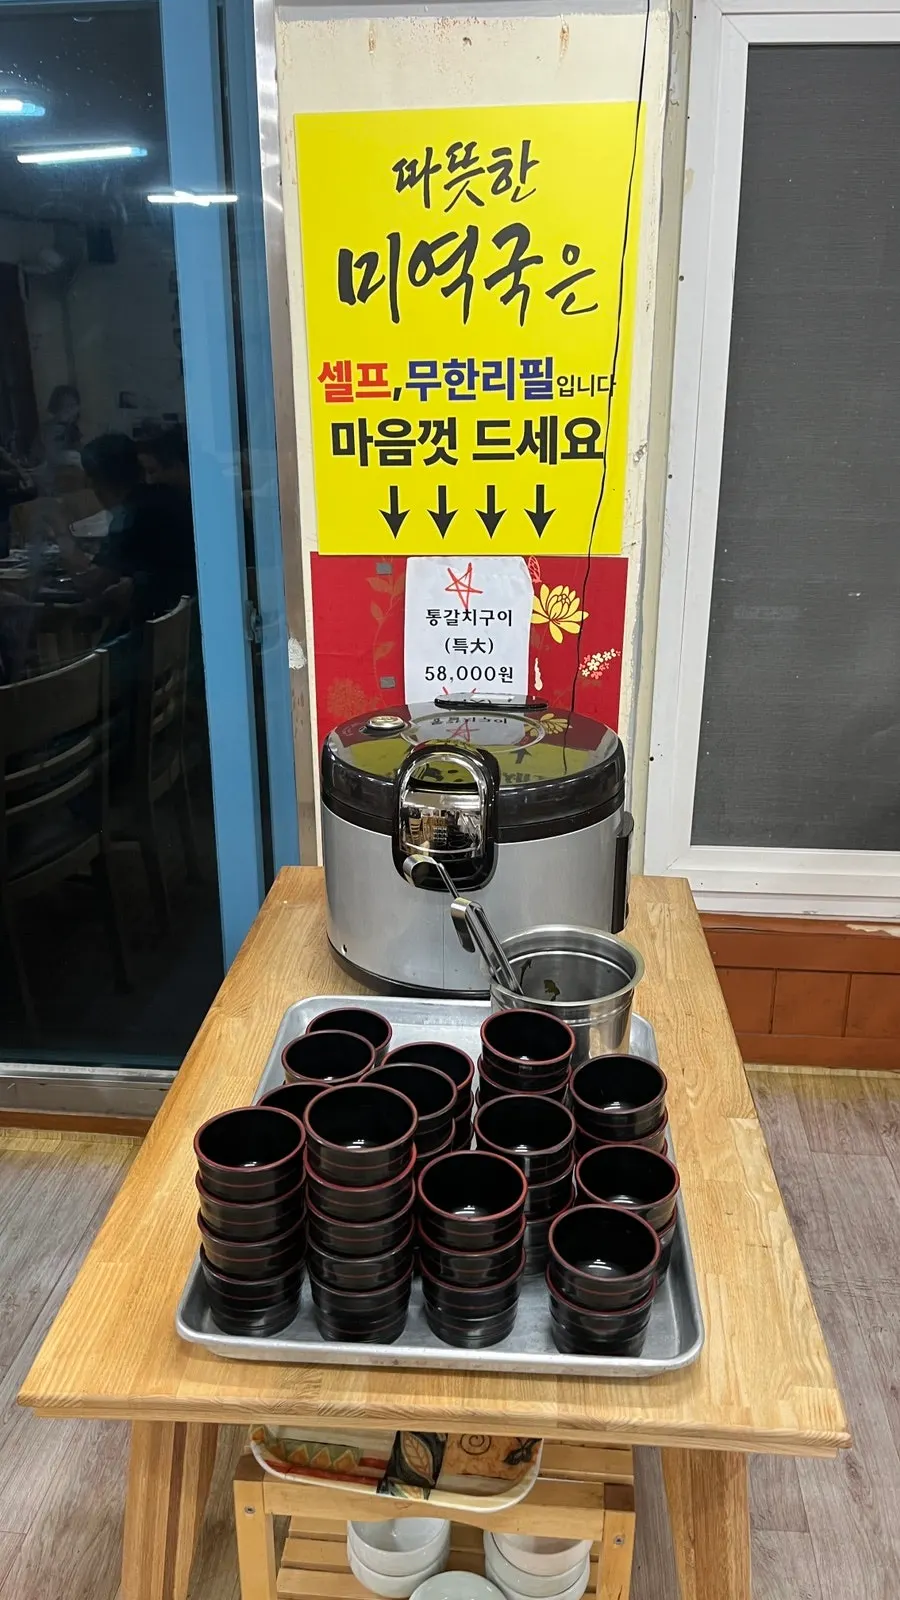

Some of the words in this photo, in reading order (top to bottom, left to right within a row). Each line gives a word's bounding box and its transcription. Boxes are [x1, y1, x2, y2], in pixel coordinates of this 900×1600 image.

[391, 139, 539, 212] 따뜻한
[337, 222, 599, 327] 미역국은
[331, 416, 459, 467] 마음껏
[472, 415, 604, 466] 드세요
[425, 608, 513, 627] 통갈치구이
[444, 637, 494, 655] (특大)
[424, 665, 513, 684] 58,000원
